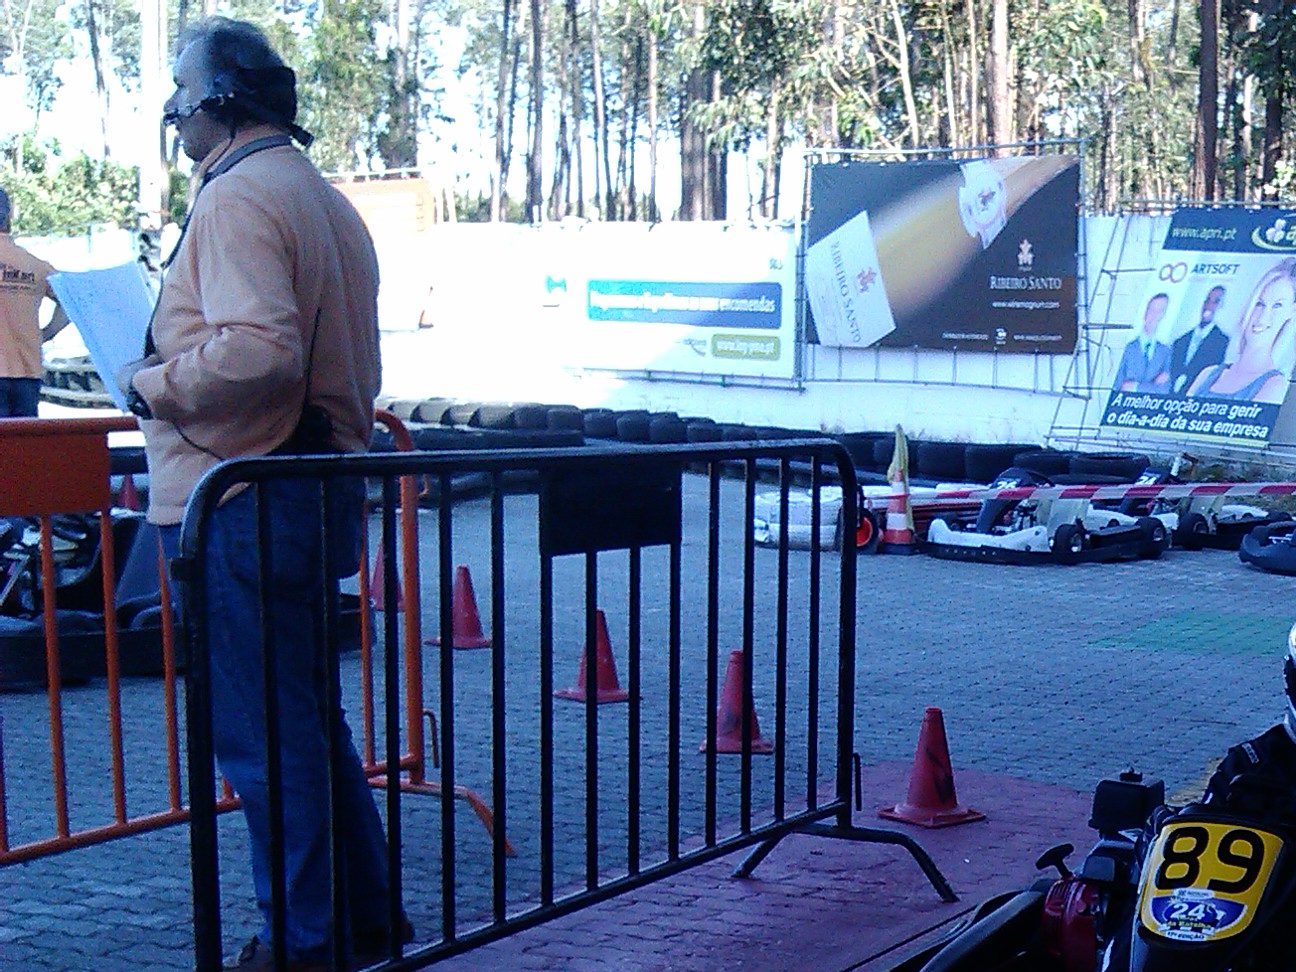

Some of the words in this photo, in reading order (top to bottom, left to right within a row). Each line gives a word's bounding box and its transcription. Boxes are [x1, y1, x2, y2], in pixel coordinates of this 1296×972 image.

[1172, 226, 1237, 241] www.apri.pt
[1190, 263, 1240, 275] ARTSOFT
[990, 276, 1027, 289] RIBEIRO
[1028, 276, 1062, 290] SANTO
[1111, 393, 1124, 407] A
[1123, 395, 1162, 410] melhor
[1163, 398, 1199, 415] opção
[1199, 403, 1228, 416] para
[1227, 404, 1263, 419] gerir
[1107, 412, 1117, 424] o
[1117, 411, 1170, 428] dia-a-dia
[1170, 416, 1187, 430] da
[1188, 420, 1212, 432] sua
[1213, 421, 1269, 438] empresa
[1154, 825, 1266, 894] 89
